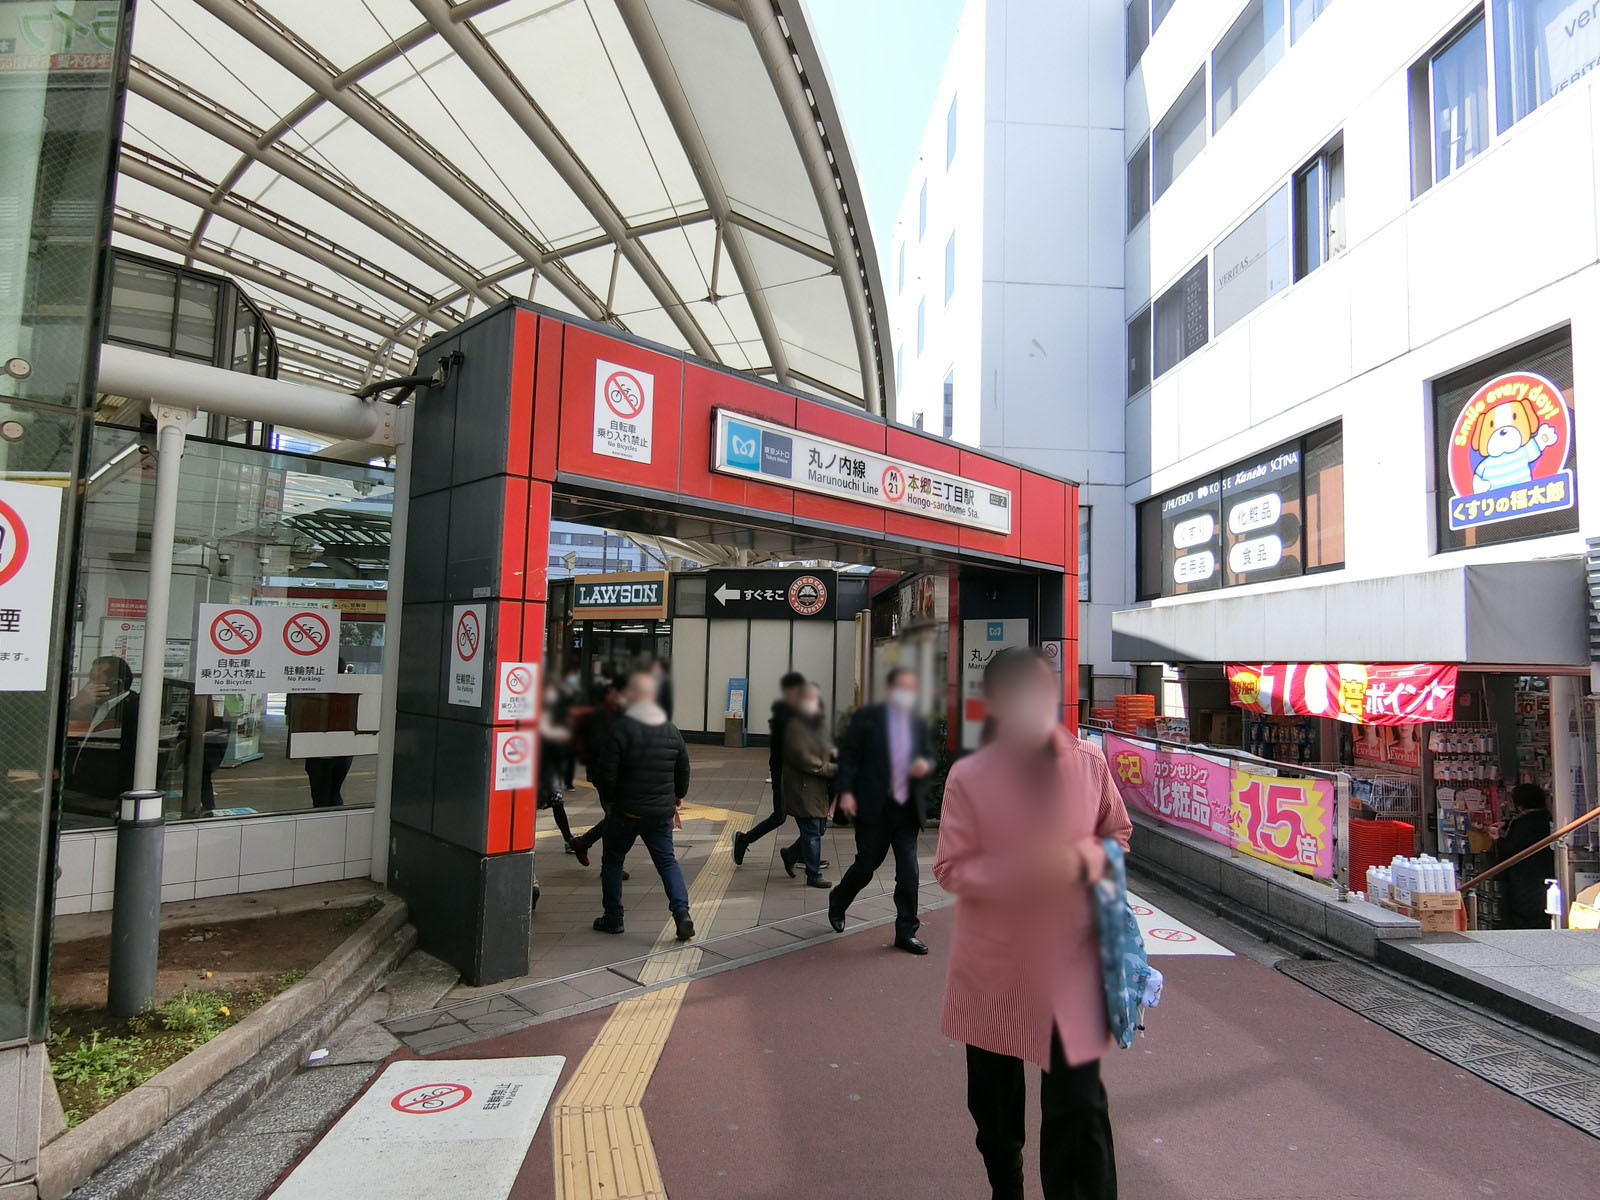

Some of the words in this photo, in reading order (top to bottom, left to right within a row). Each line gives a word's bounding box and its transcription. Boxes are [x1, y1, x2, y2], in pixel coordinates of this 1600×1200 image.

[1455, 401, 1486, 446] Smile
[1486, 382, 1530, 403] every
[1528, 384, 1560, 420] day!
[611, 420, 636, 433] 自転車
[597, 428, 648, 448] 乗り入れ禁止
[617, 443, 637, 452] Bicycles
[808, 448, 866, 479] 丸ノ内線
[808, 469, 859, 492] Marunouchi
[862, 482, 879, 496] Line
[890, 472, 898, 482] M
[1235, 465, 1267, 485] Kanebo
[888, 483, 898, 494] 21
[908, 474, 974, 505] 本郷三丁目駅
[907, 493, 966, 516] Hongo-sanchome
[967, 508, 980, 519] Sta.
[1453, 481, 1565, 521] くすりの福太郎
[1243, 544, 1267, 566] 食品
[579, 584, 657, 604] LAWSON
[744, 589, 785, 601] すぐそこ
[218, 658, 251, 668] 自転車
[971, 648, 1001, 662] 丸ノ
[201, 668, 266, 679] 乗り入れ禁止
[284, 666, 325, 676] 駐輪禁止
[1153, 761, 1208, 784] カウンセリング
[1153, 778, 1211, 826] 化粧品
